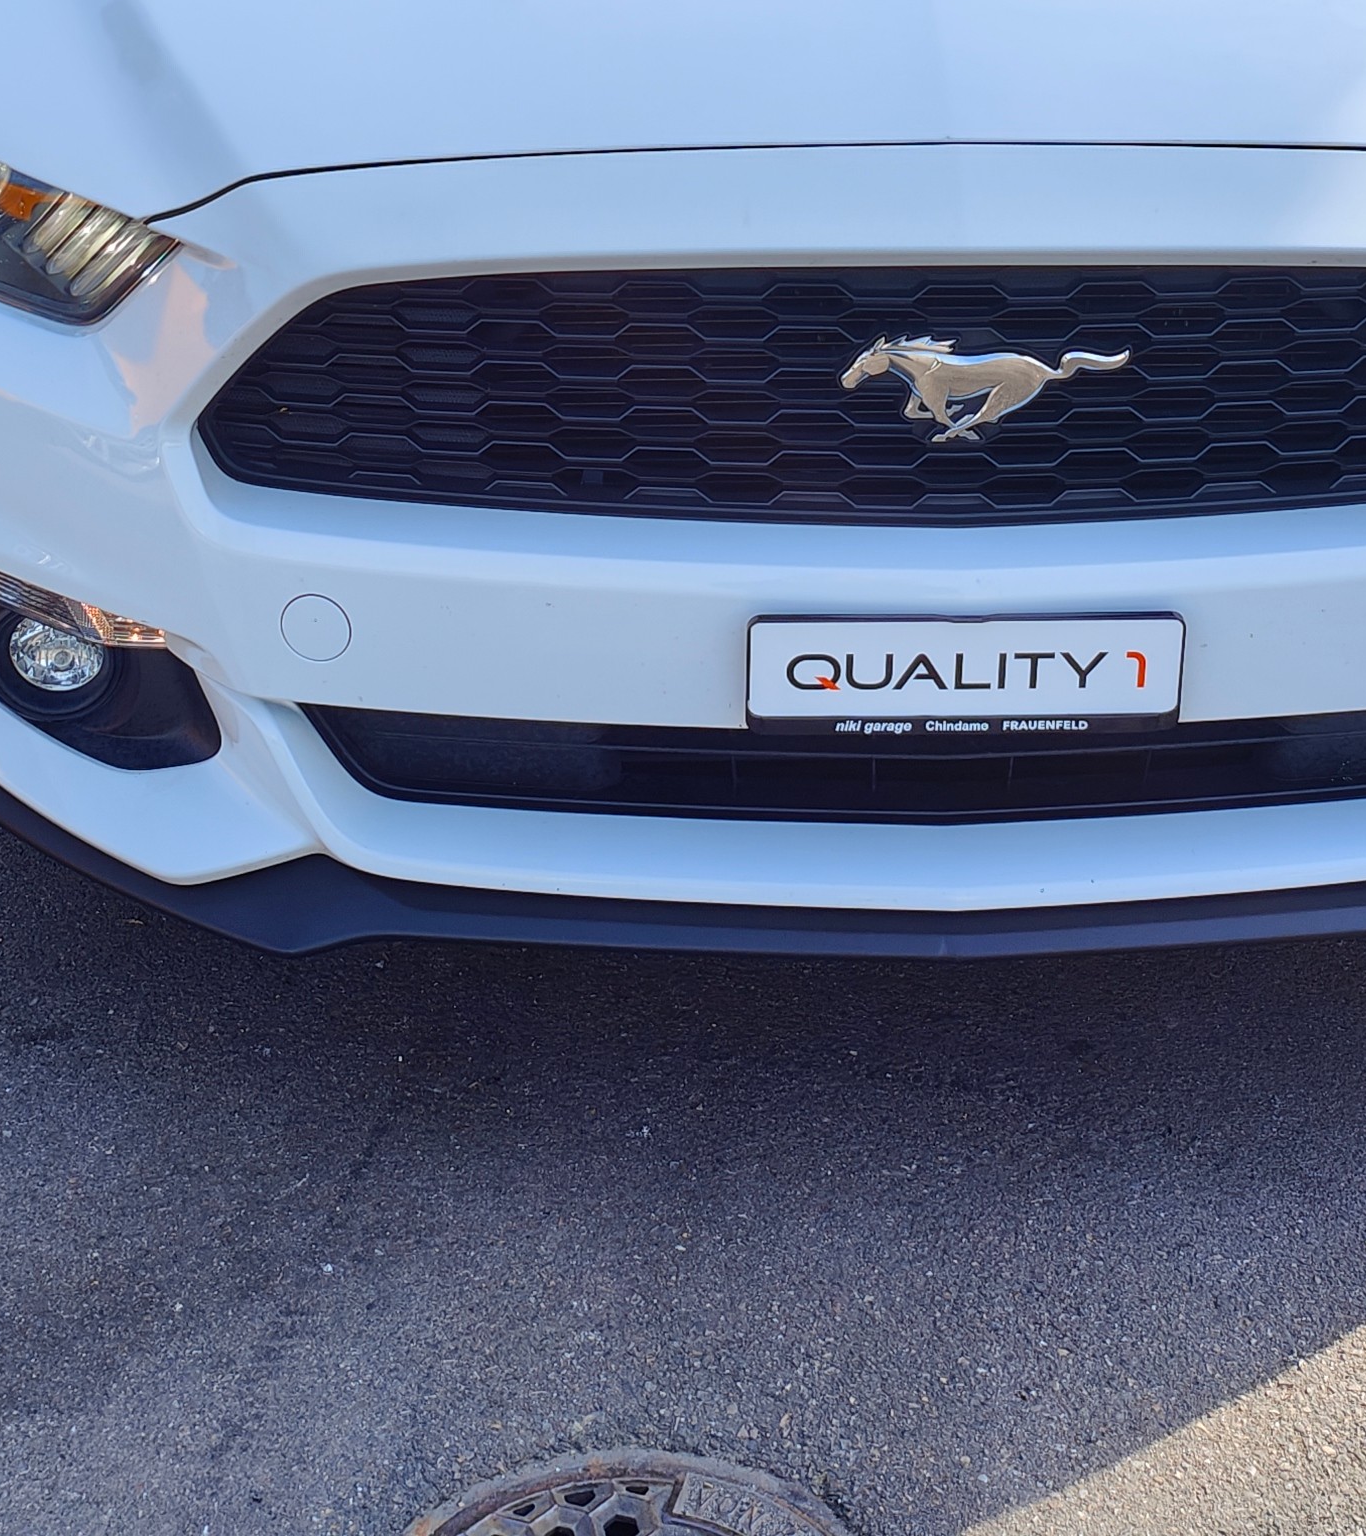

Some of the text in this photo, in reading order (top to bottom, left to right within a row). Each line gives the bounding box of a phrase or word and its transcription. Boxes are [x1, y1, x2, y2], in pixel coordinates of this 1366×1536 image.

[785, 651, 1147, 691] QUALITY 1
[835, 720, 1089, 734] niki garage Chindamo FRAUENFELD
